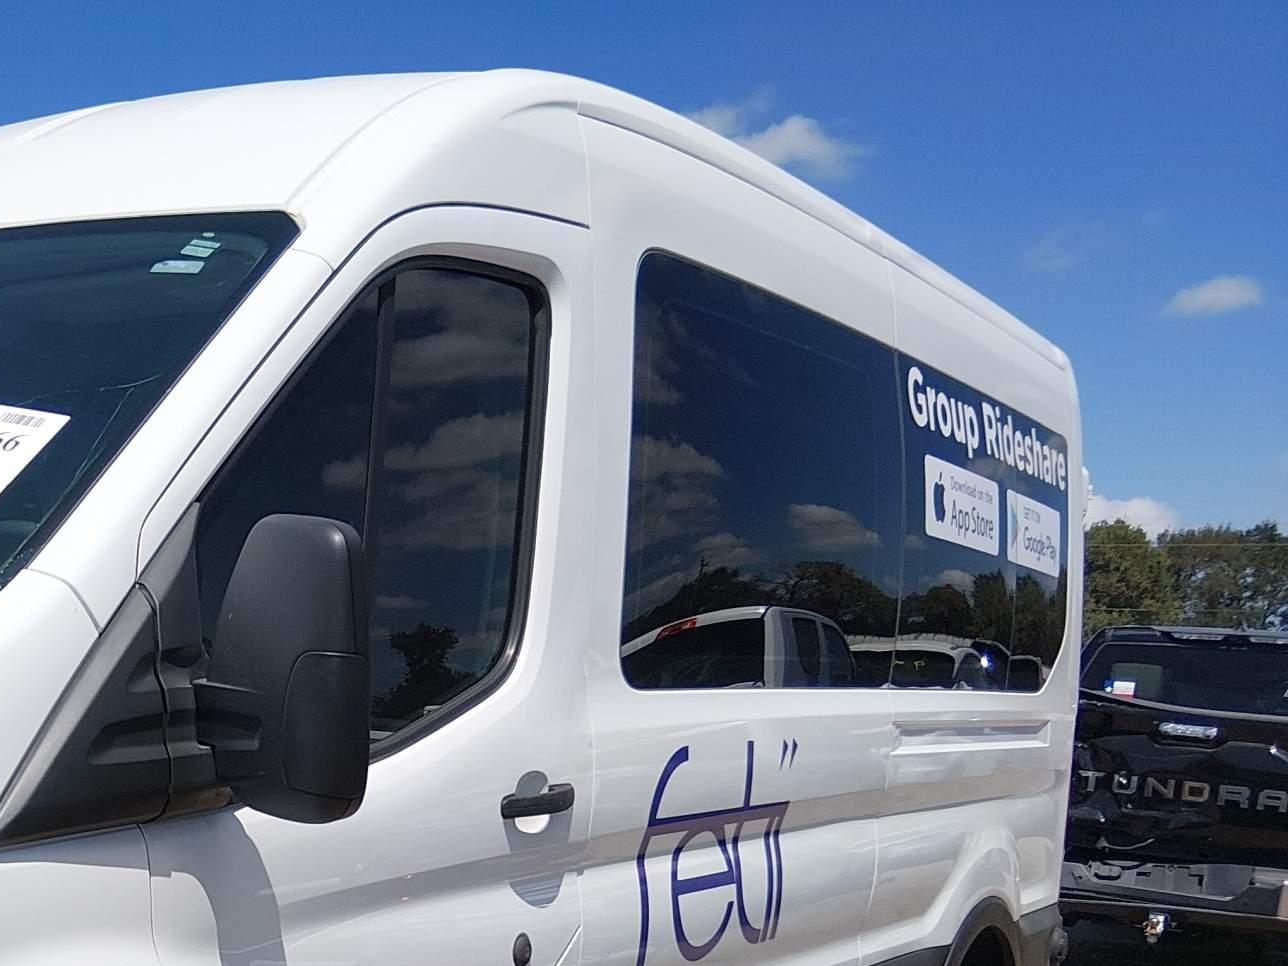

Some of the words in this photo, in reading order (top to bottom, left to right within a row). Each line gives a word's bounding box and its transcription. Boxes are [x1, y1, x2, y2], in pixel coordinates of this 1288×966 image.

[907, 366, 979, 458] Group
[981, 401, 1066, 491] Rideshare
[950, 500, 971, 539] App
[971, 507, 994, 540] Store
[1023, 526, 1046, 562] Google
[1078, 769, 1288, 812] TUNDRA
